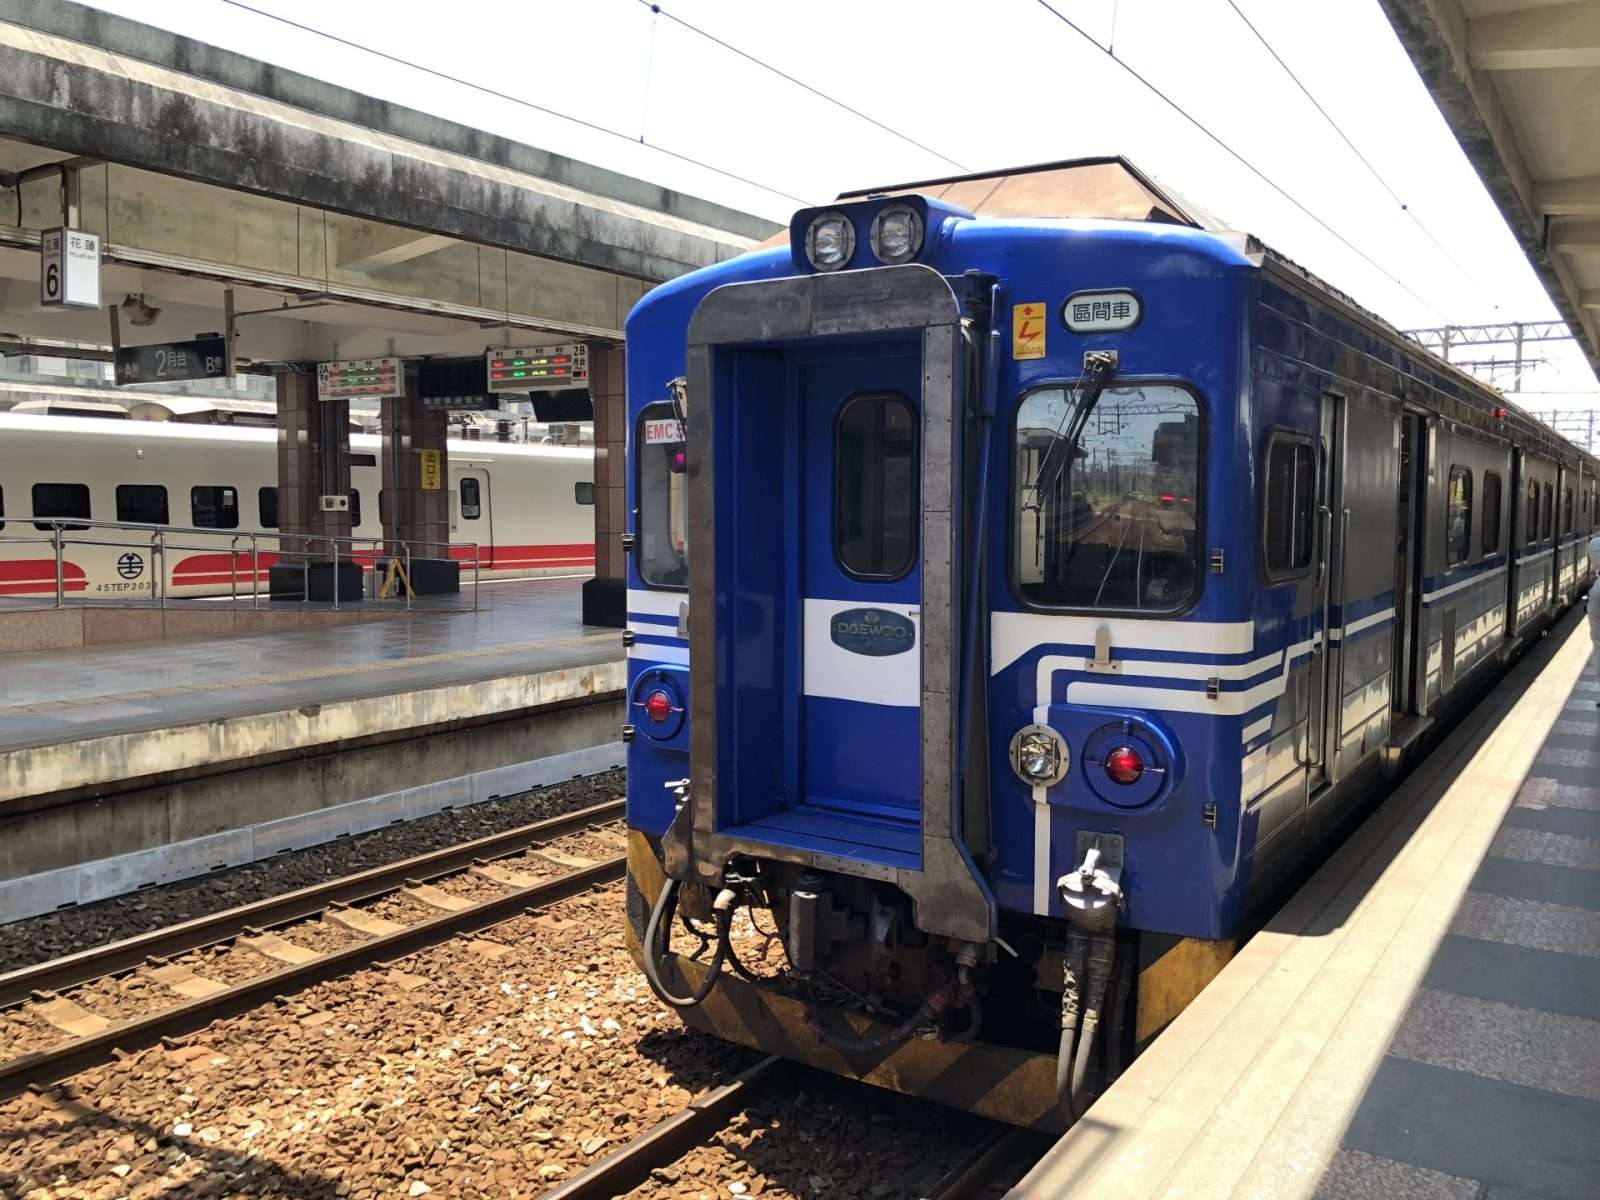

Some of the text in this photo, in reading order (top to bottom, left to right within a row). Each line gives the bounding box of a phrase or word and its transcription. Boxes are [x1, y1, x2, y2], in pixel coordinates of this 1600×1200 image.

[70, 237, 96, 252] 花蓮
[47, 264, 59, 297] 6
[1073, 301, 1131, 322] 區間車
[573, 345, 585, 356] 2B
[647, 423, 673, 441] EMC
[96, 581, 159, 592] 45TEP203
[837, 622, 906, 639] DAEWOO
